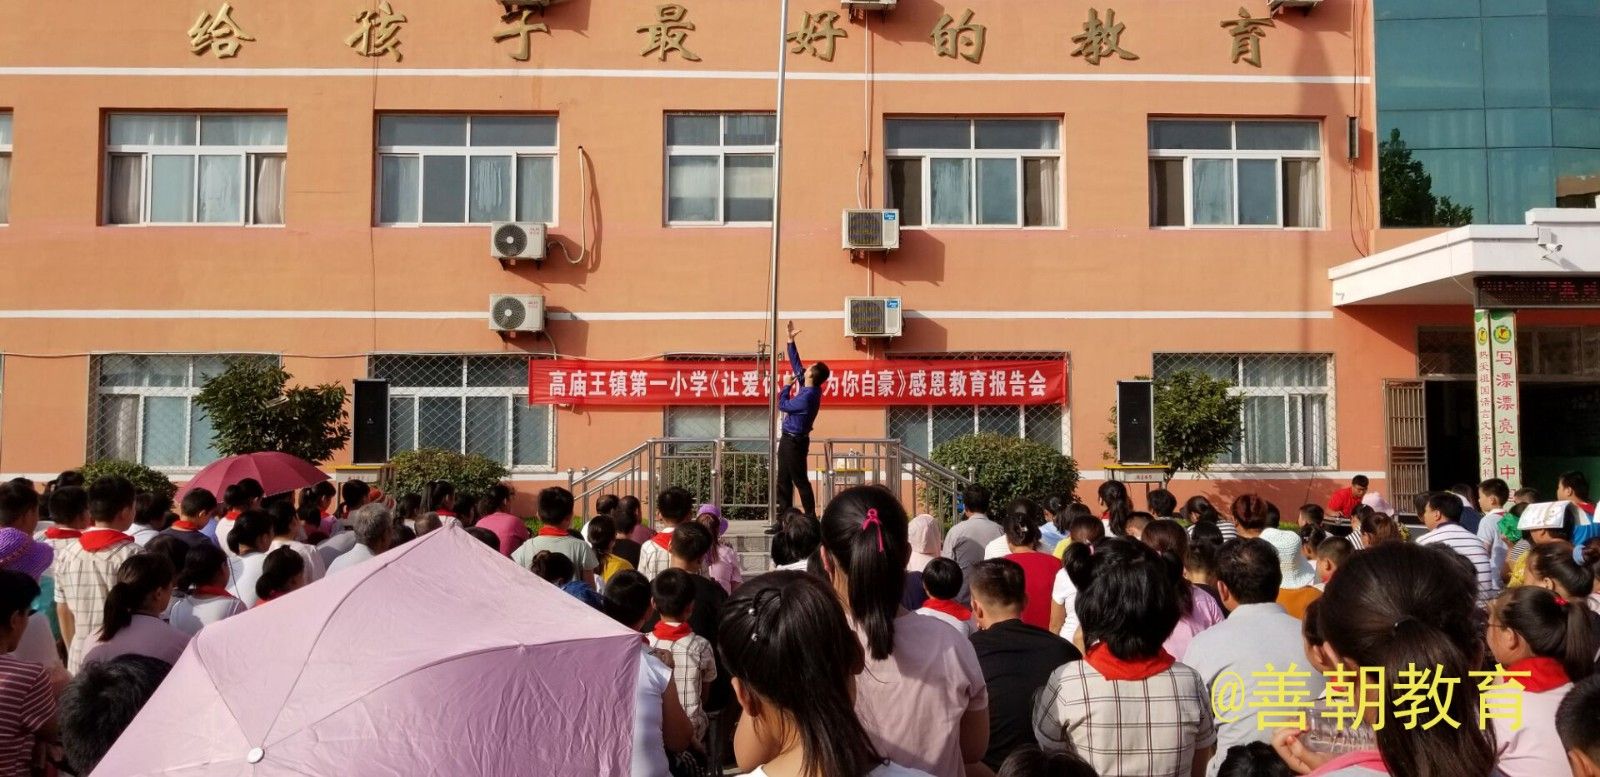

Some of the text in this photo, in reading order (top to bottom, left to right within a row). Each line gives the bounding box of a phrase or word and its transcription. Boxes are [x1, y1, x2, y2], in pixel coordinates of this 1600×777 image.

[187, 1, 1276, 69] 给孩子最好的教育
[548, 369, 1048, 398] 高庙王镇第一小学《让爱你为你自豪》感恩教育报告会
